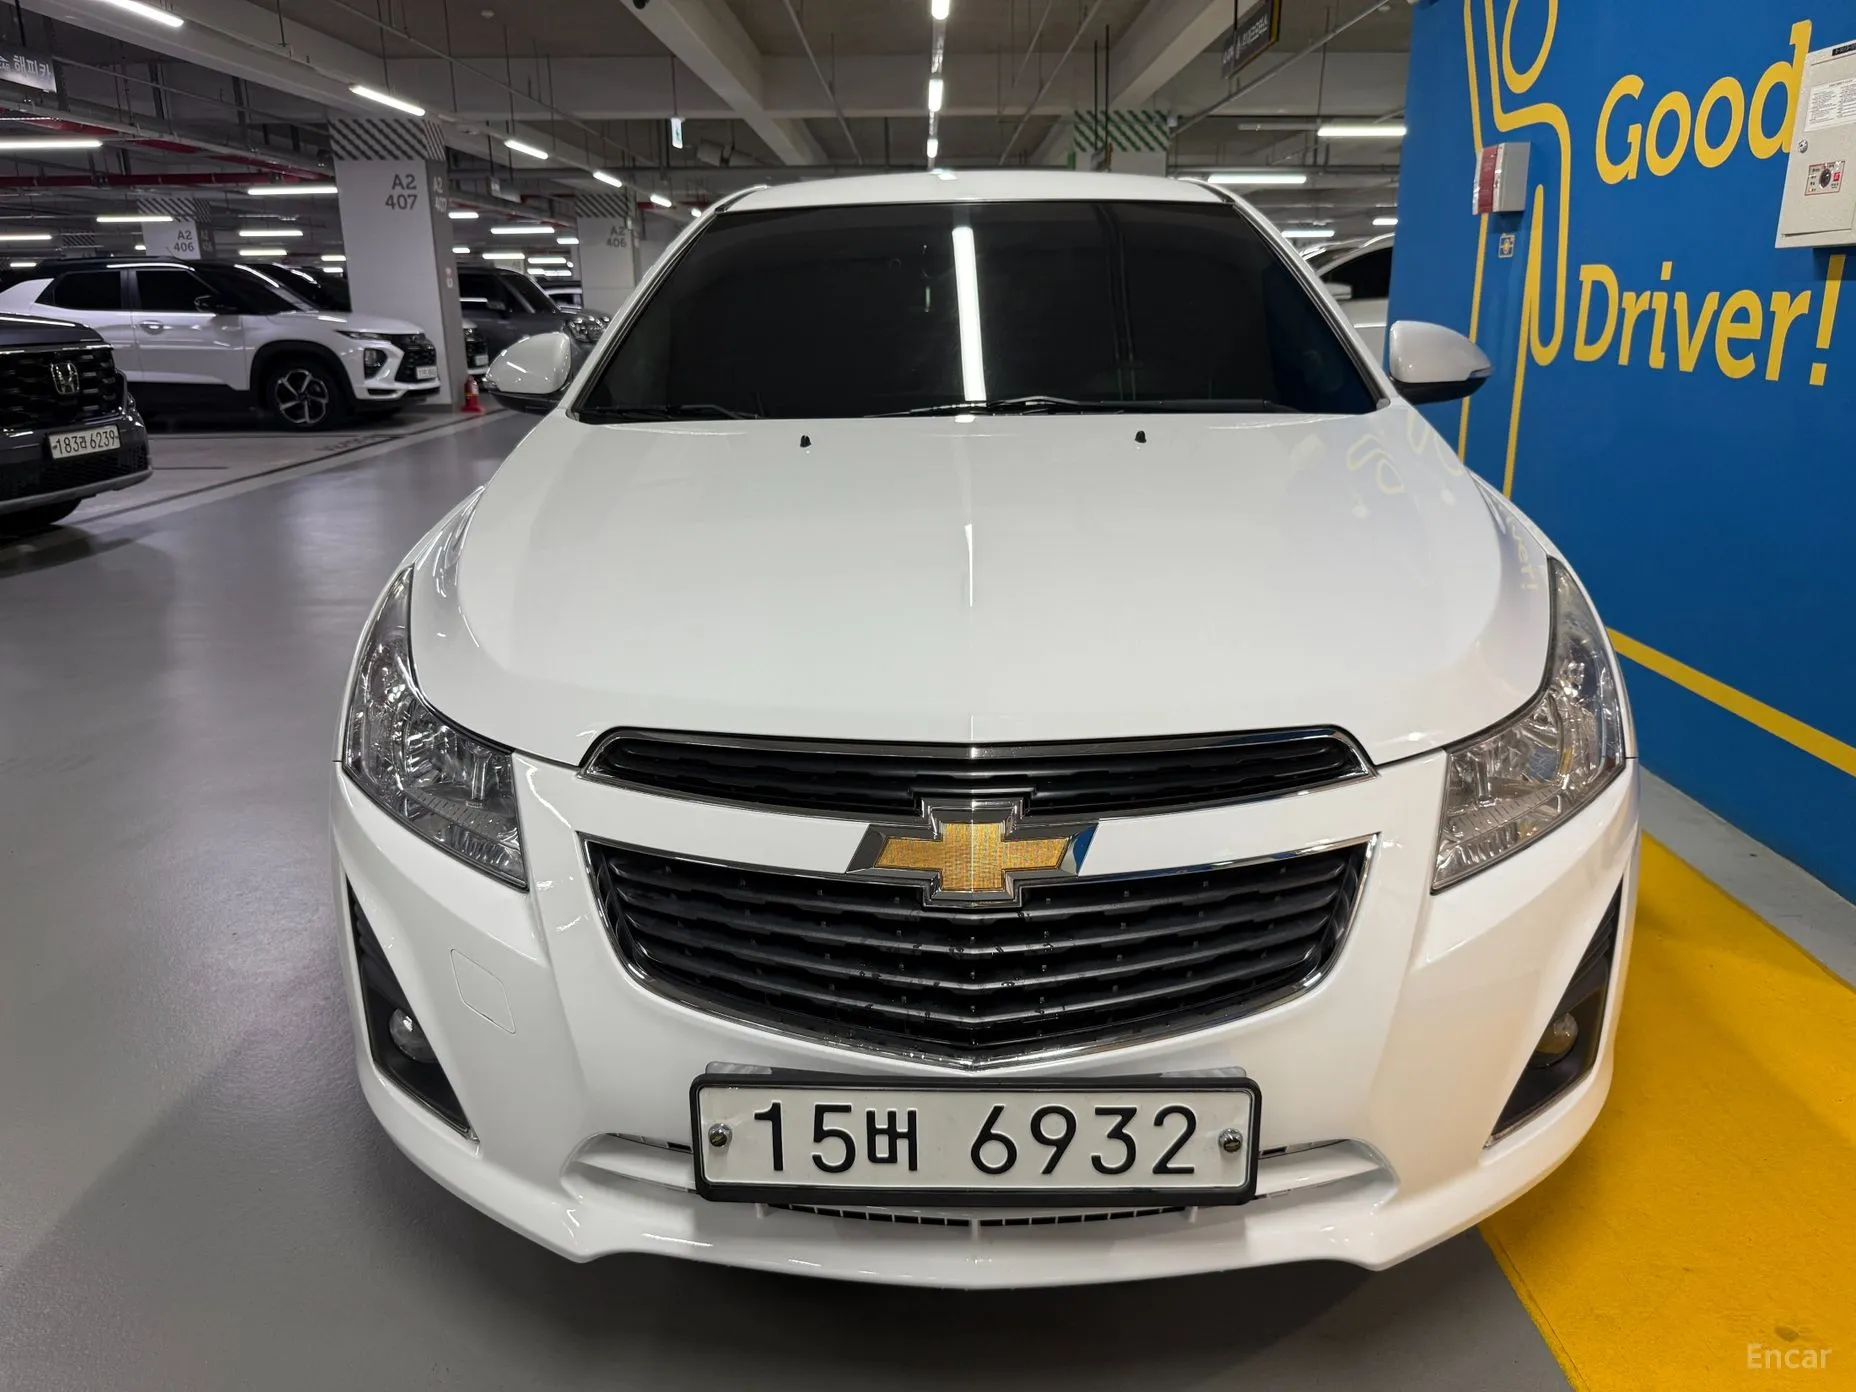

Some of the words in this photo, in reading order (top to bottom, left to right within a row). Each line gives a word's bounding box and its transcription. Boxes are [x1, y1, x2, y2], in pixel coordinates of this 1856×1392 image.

[1595, 19, 1812, 185] Good
[391, 174, 417, 190] A2
[385, 194, 418, 210] 407
[177, 230, 193, 240] A2
[610, 225, 626, 236] A2
[174, 242, 195, 252] 406
[1573, 261, 1846, 386] Driver!
[90, 429, 115, 449] 6239
[754, 1101, 917, 1173] 15버
[970, 1104, 1198, 1175] 6932
